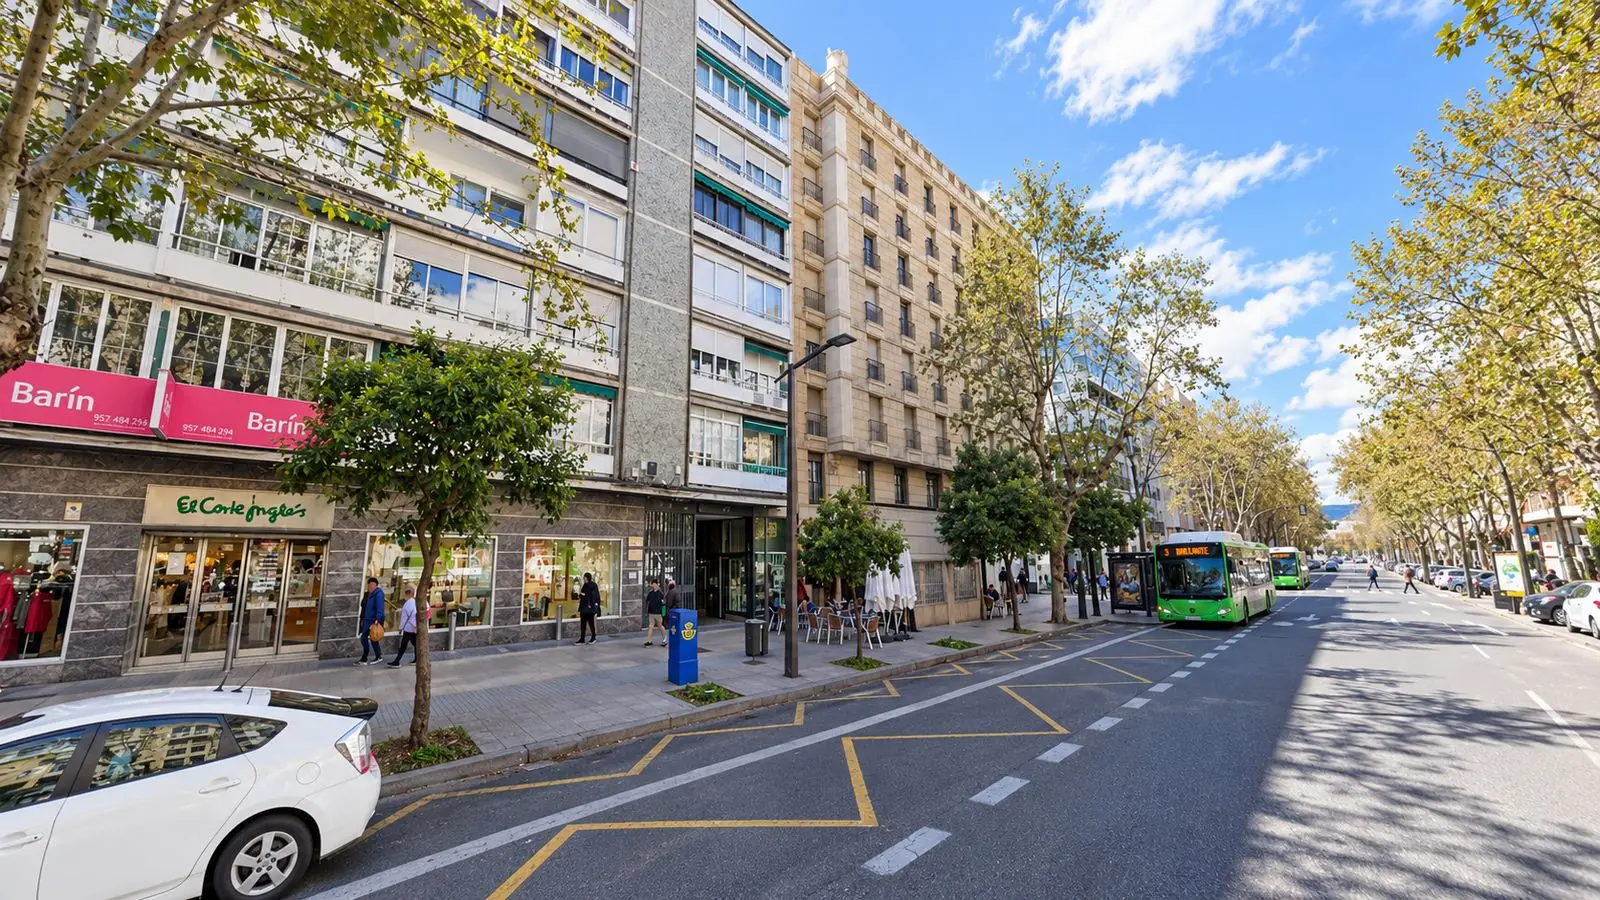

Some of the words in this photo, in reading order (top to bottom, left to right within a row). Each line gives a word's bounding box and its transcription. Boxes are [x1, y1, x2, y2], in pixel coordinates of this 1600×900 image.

[11, 381, 95, 412] Barín
[93, 413, 111, 422] 957
[112, 416, 130, 425] 484
[247, 411, 306, 436] Barín
[182, 423, 198, 433] 957
[200, 425, 216, 434] 484
[218, 427, 233, 436] 294
[177, 495, 198, 514] El
[199, 496, 245, 515] Corte
[1163, 548, 1170, 557] 3
